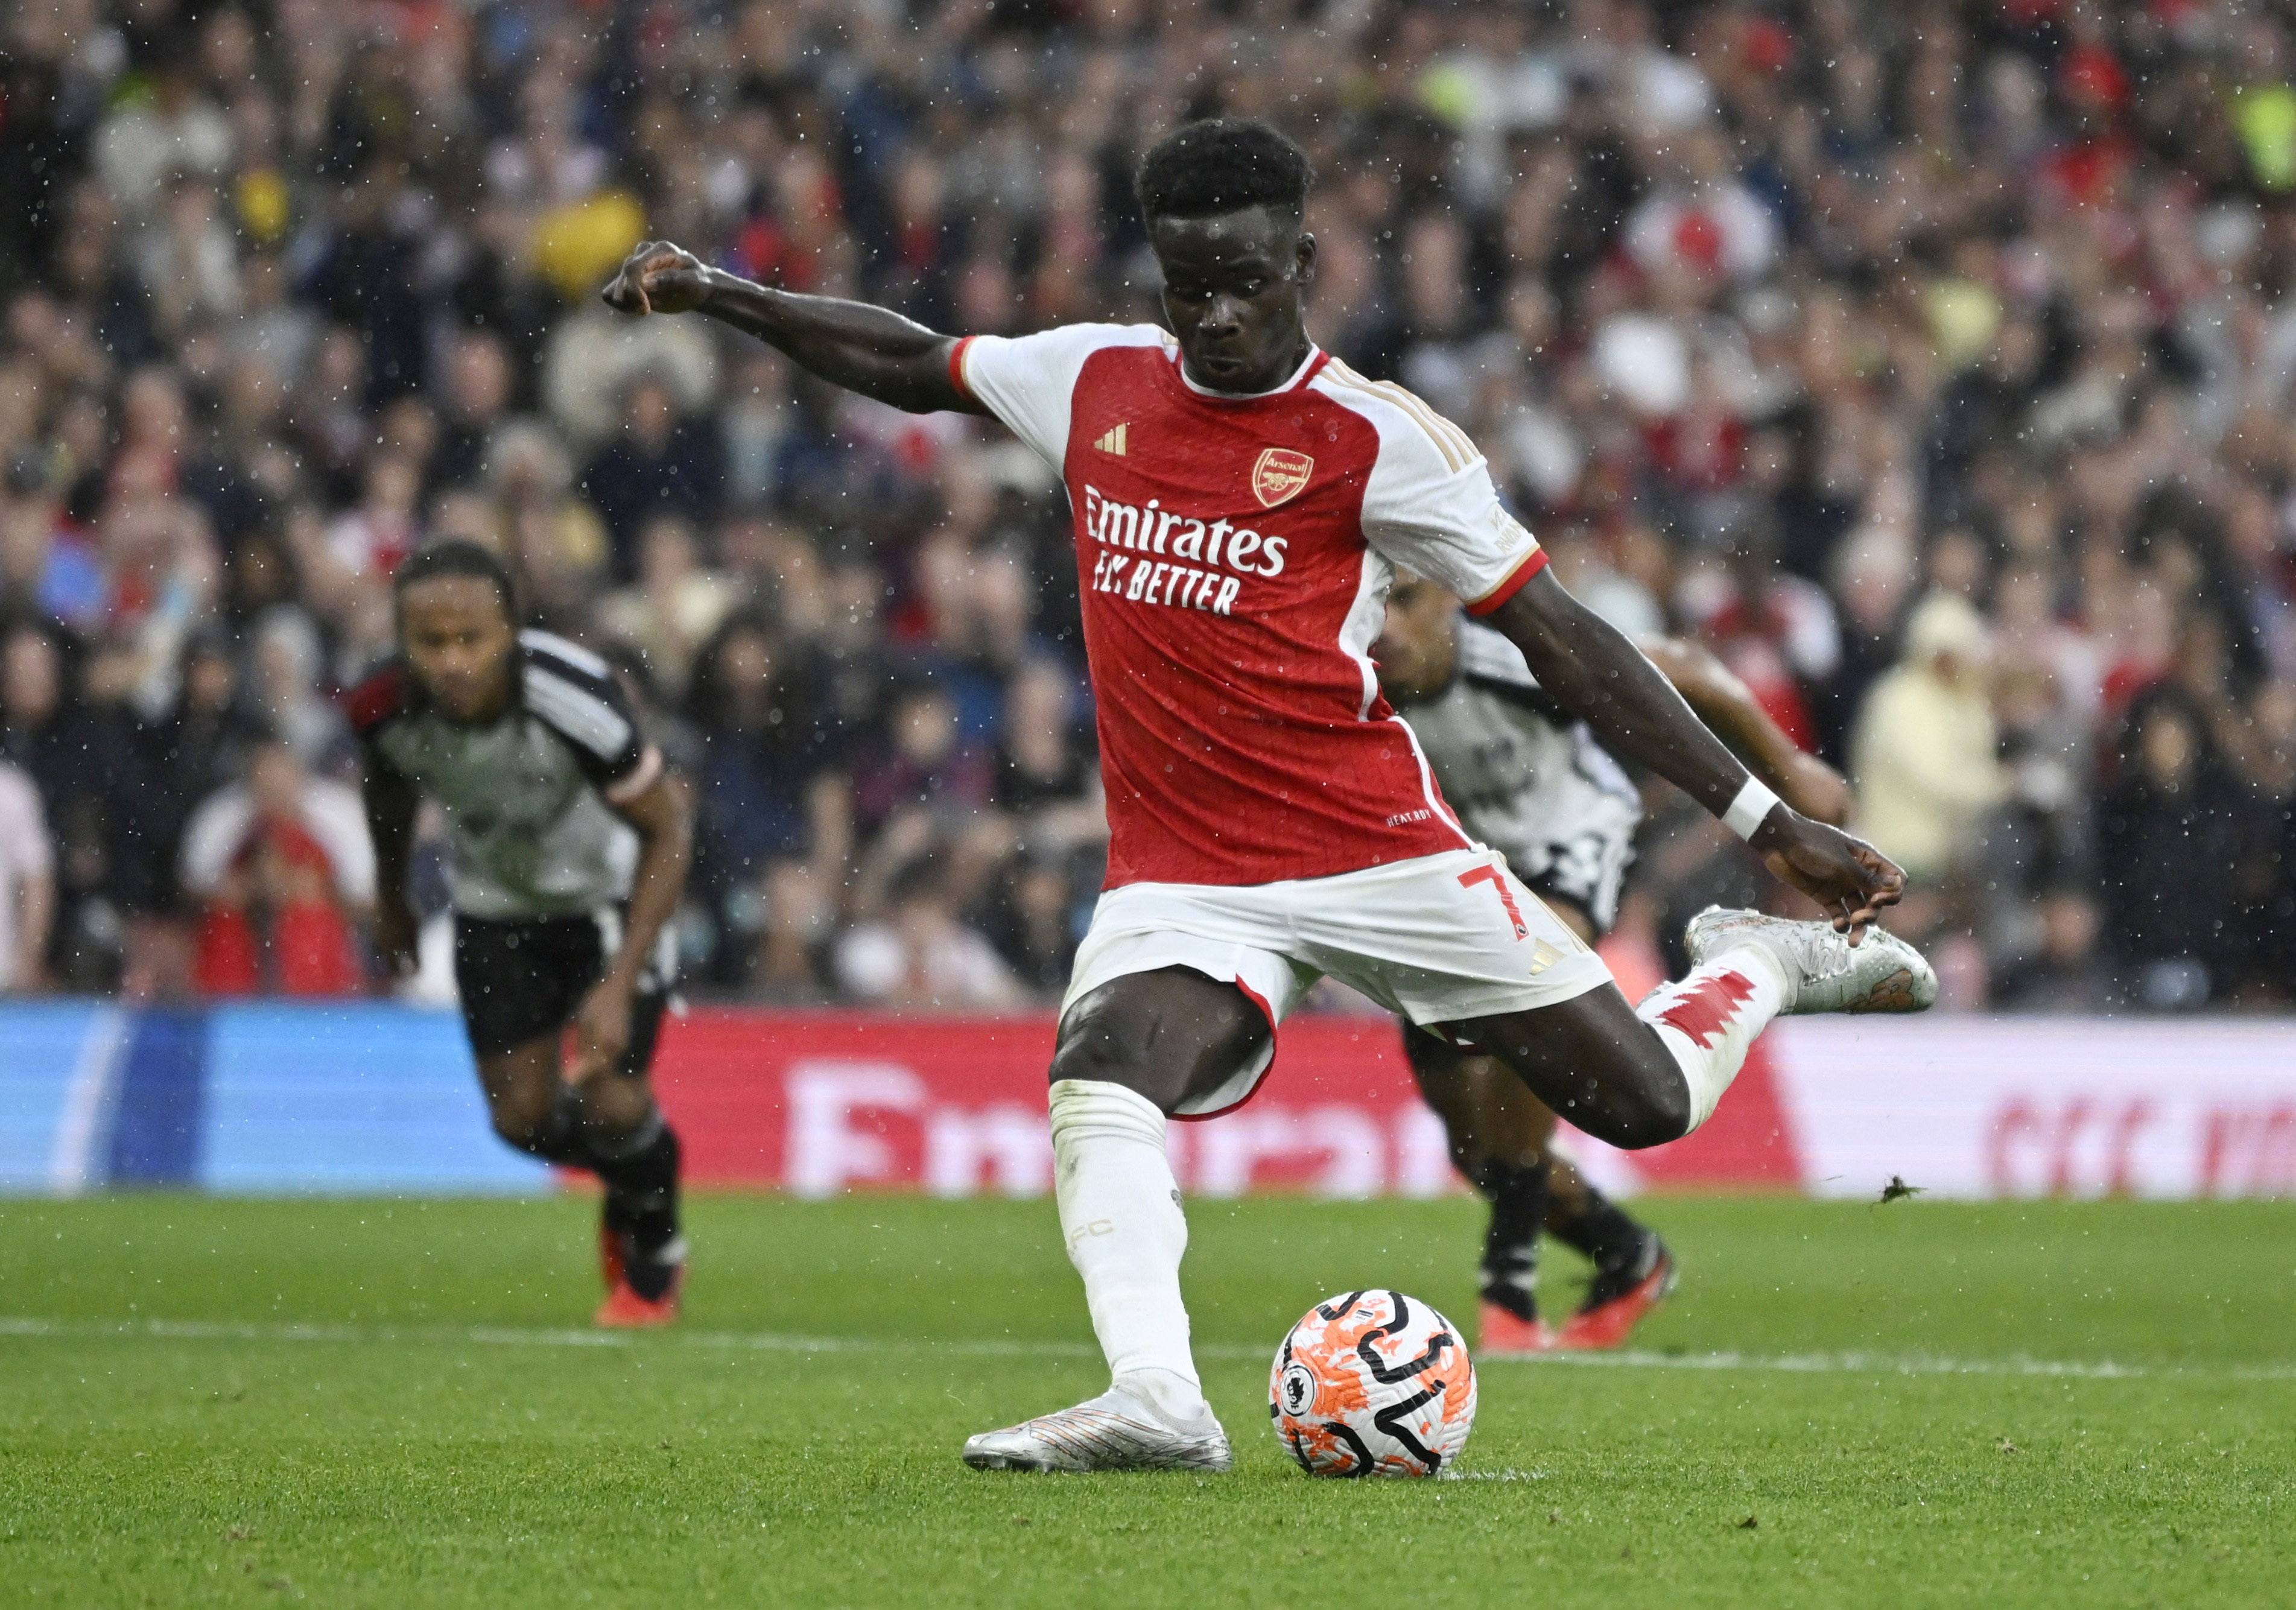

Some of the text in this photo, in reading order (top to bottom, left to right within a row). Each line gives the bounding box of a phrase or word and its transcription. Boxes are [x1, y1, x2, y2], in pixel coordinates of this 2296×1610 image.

[1266, 457, 1305, 472] Arsenal
[1085, 484, 1289, 577] Emirates
[1126, 560, 1240, 615] BETTER
[1387, 809, 1432, 828] HEAT.RDY
[1457, 864, 1530, 942] 7
